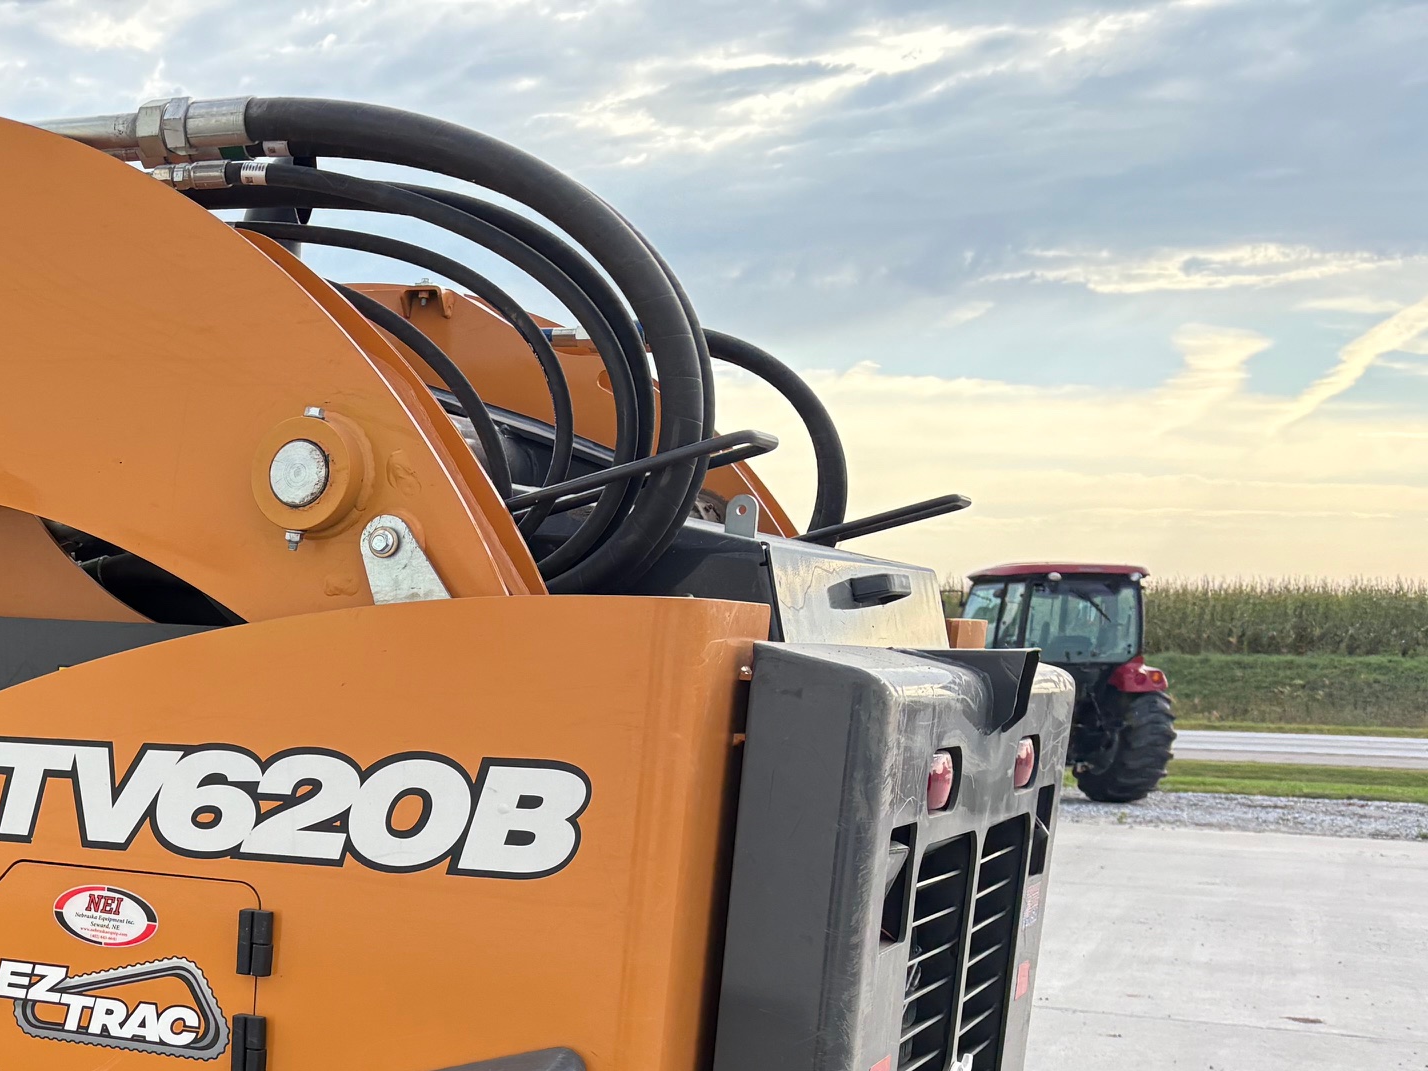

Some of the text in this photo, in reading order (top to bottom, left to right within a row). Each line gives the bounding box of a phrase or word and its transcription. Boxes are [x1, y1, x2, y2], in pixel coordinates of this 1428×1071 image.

[85, 893, 124, 915] NEI
[75, 912, 98, 920] Nebraska
[98, 915, 125, 924] Equipment
[90, 921, 110, 930] Seward,
[57, 991, 201, 1047] TRAC
